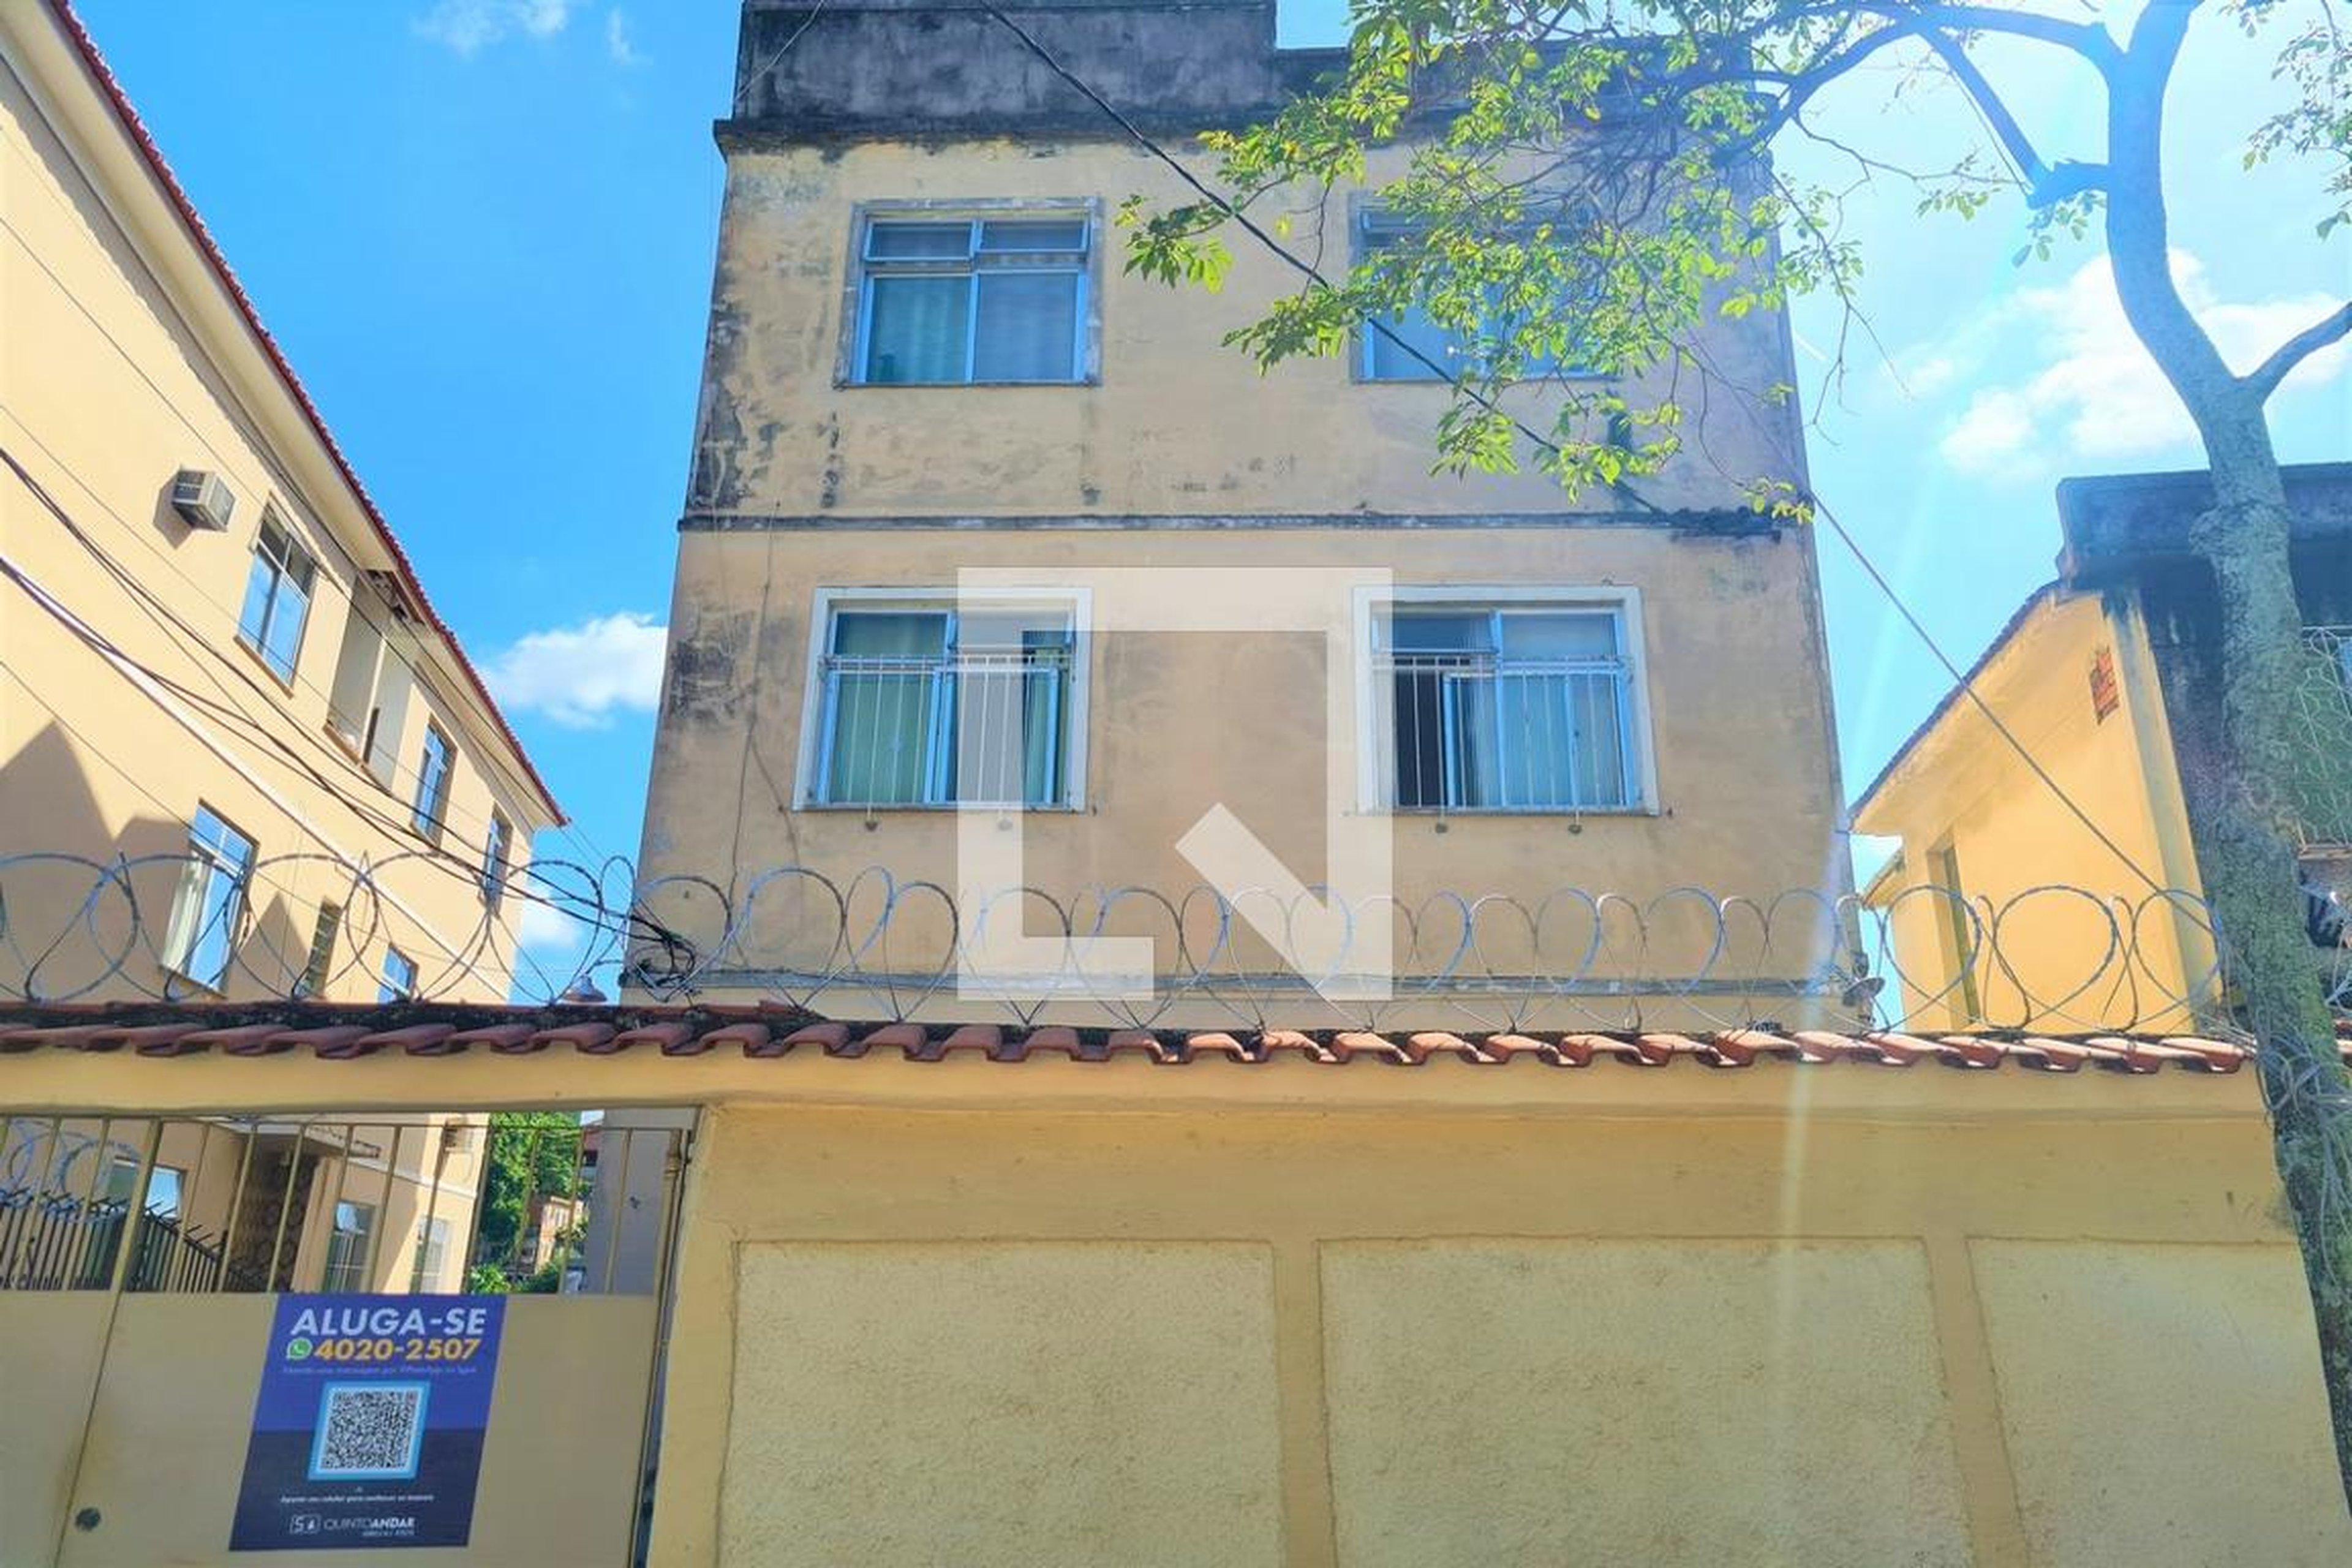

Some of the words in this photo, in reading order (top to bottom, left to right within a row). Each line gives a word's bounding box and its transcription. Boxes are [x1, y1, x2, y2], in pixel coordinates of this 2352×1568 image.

[290, 1308, 487, 1336] ALUGA-SE
[314, 1338, 481, 1360] 4020-2507
[323, 1517, 415, 1531] QUINTOANDAR
